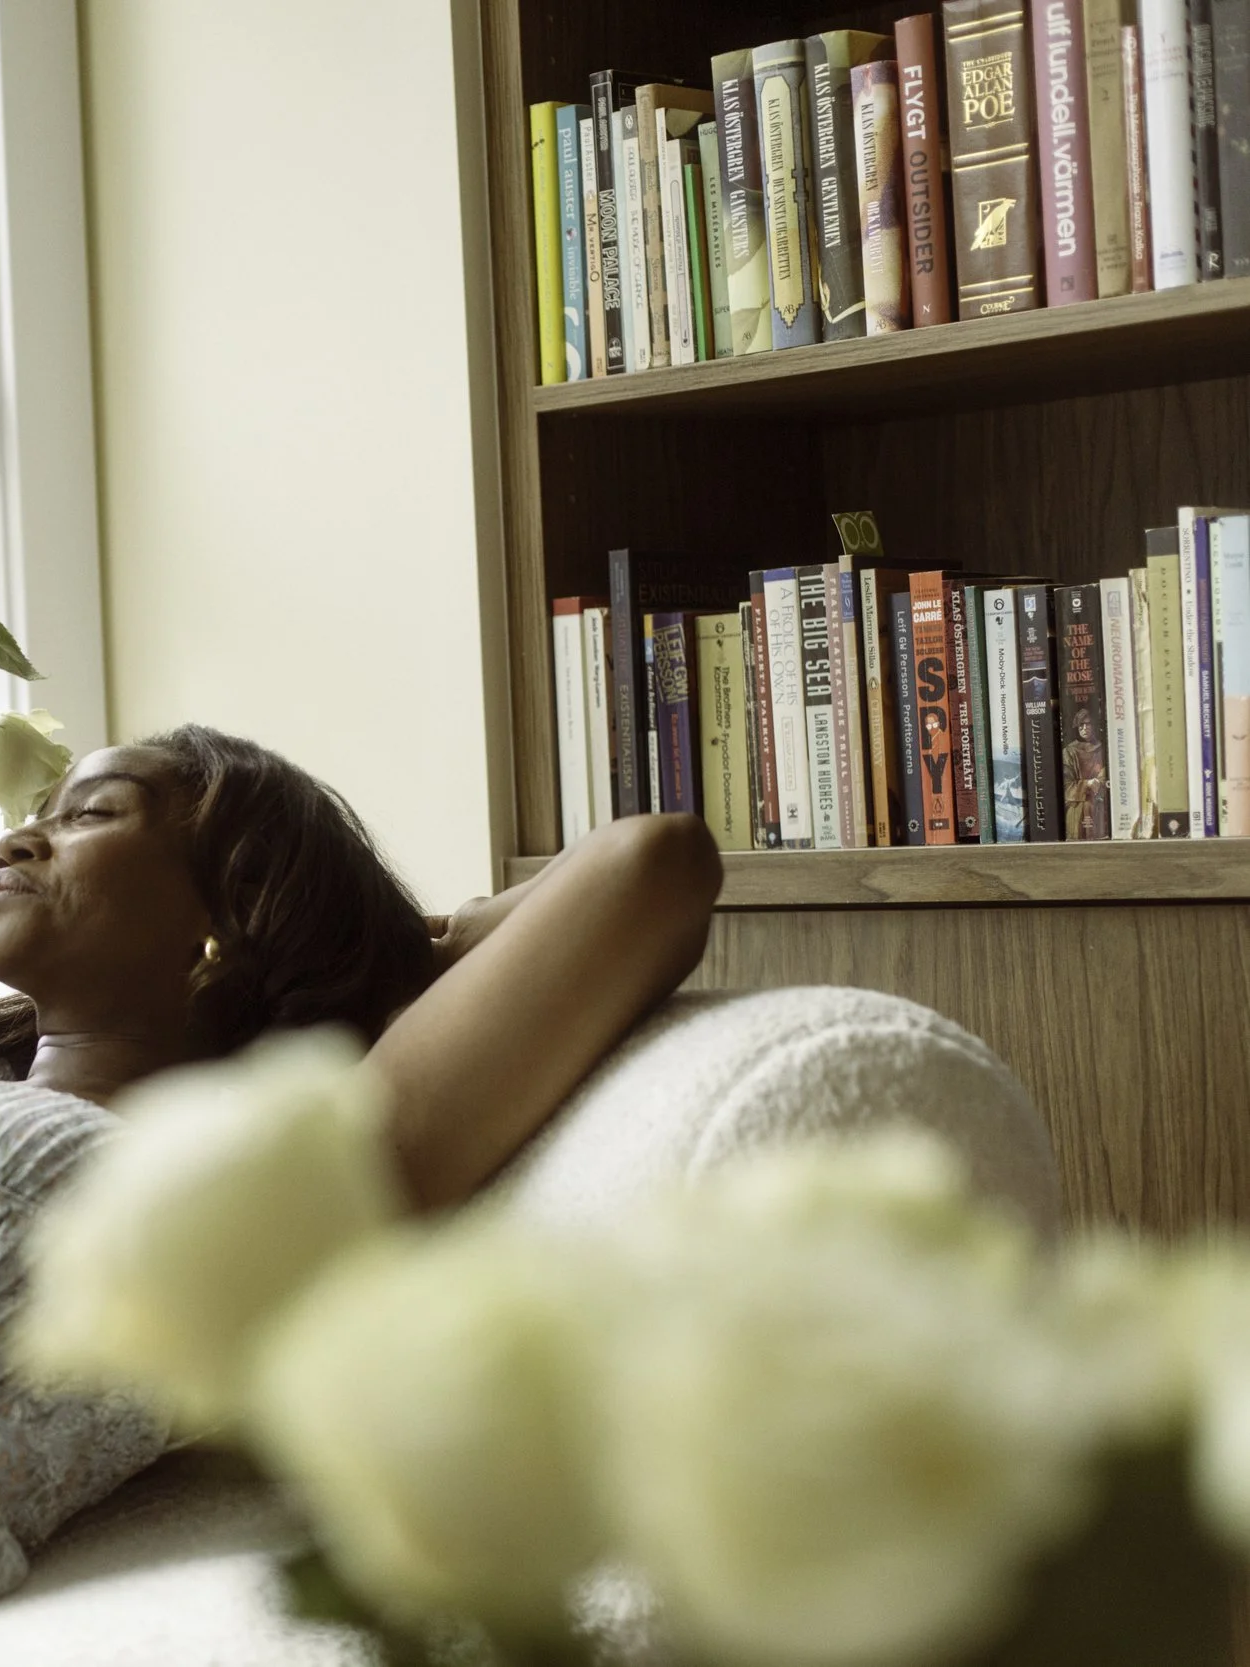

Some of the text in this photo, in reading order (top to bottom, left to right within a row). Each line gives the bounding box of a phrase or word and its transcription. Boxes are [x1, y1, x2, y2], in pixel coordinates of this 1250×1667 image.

[1046, 1, 1072, 38] ulf
[902, 64, 927, 140] FLYGT
[962, 62, 1014, 86] EDGAR
[963, 78, 1014, 98] ALLAN
[722, 79, 746, 183] KLAS ÖSTERGREN
[768, 98, 784, 173] KLAS ÖSTERGREN
[814, 62, 836, 169] KLAS ÖSTERGREN
[963, 90, 1015, 125] POE
[559, 128, 577, 218] paul auster
[583, 126, 594, 182] Paul Auster
[861, 103, 879, 192] KLAS ÖSTERGREN
[1130, 116, 1143, 194] Metamorphosis
[773, 178, 784, 194] DEN
[774, 195, 787, 221] SISTA
[820, 176, 841, 248] GENTLEMEN
[909, 151, 934, 276] OUTSIDER
[1133, 202, 1144, 228] Franz
[599, 189, 620, 310] MOON PALACE
[709, 176, 721, 270] LES MISÉRABLES
[730, 190, 750, 259] GANGSTERS
[1135, 230, 1145, 260] Kafka
[567, 246, 580, 300] invisible
[799, 572, 831, 697] THE BIG SEA
[864, 577, 876, 669] Leslie Marmon Silko
[913, 601, 932, 610] JOHN
[913, 609, 942, 623] CARRÉ
[1067, 623, 1089, 636] THE
[1182, 528, 1196, 677] SORRENTINO Under the Shadow
[653, 632, 679, 701] PERSSON
[663, 628, 688, 695] LEIF GW
[769, 609, 785, 705] OF HIS OWN
[780, 587, 799, 706] A FROLIC OF HIS
[997, 648, 1006, 690] Moby-Dick
[1064, 634, 1095, 648] NAME
[1069, 658, 1089, 670] THE
[1072, 646, 1086, 659] OF
[1111, 618, 1124, 721] NEUROMANCER
[1160, 567, 1172, 729] DOCTOR FAUSTUS
[713, 666, 724, 728] Karamazov
[722, 666, 733, 729] The Brothers
[754, 608, 770, 754] FLAUBERT'S PARROT
[829, 578, 849, 779] FRANZ KAFKA THE TRIAL
[897, 611, 914, 775] Leif GW Persson Profitörerna
[951, 591, 973, 790] KLAS ÖSTERGREN TRE PORTRÄTT
[1025, 701, 1047, 709] WILLIAM
[1066, 669, 1094, 683] ROSE
[1203, 669, 1211, 701] SAMUEL
[619, 684, 632, 789] EXISTENTIALISM
[813, 712, 832, 768] LANGSTON
[1026, 707, 1046, 715] GIBSON
[1031, 719, 1042, 783] VIRTUAL
[1116, 728, 1126, 768] WILLIAM
[720, 733, 734, 833] Fyodor Dostoevsky
[818, 770, 834, 812] HUGHES
[1118, 770, 1128, 807] GIBSON
